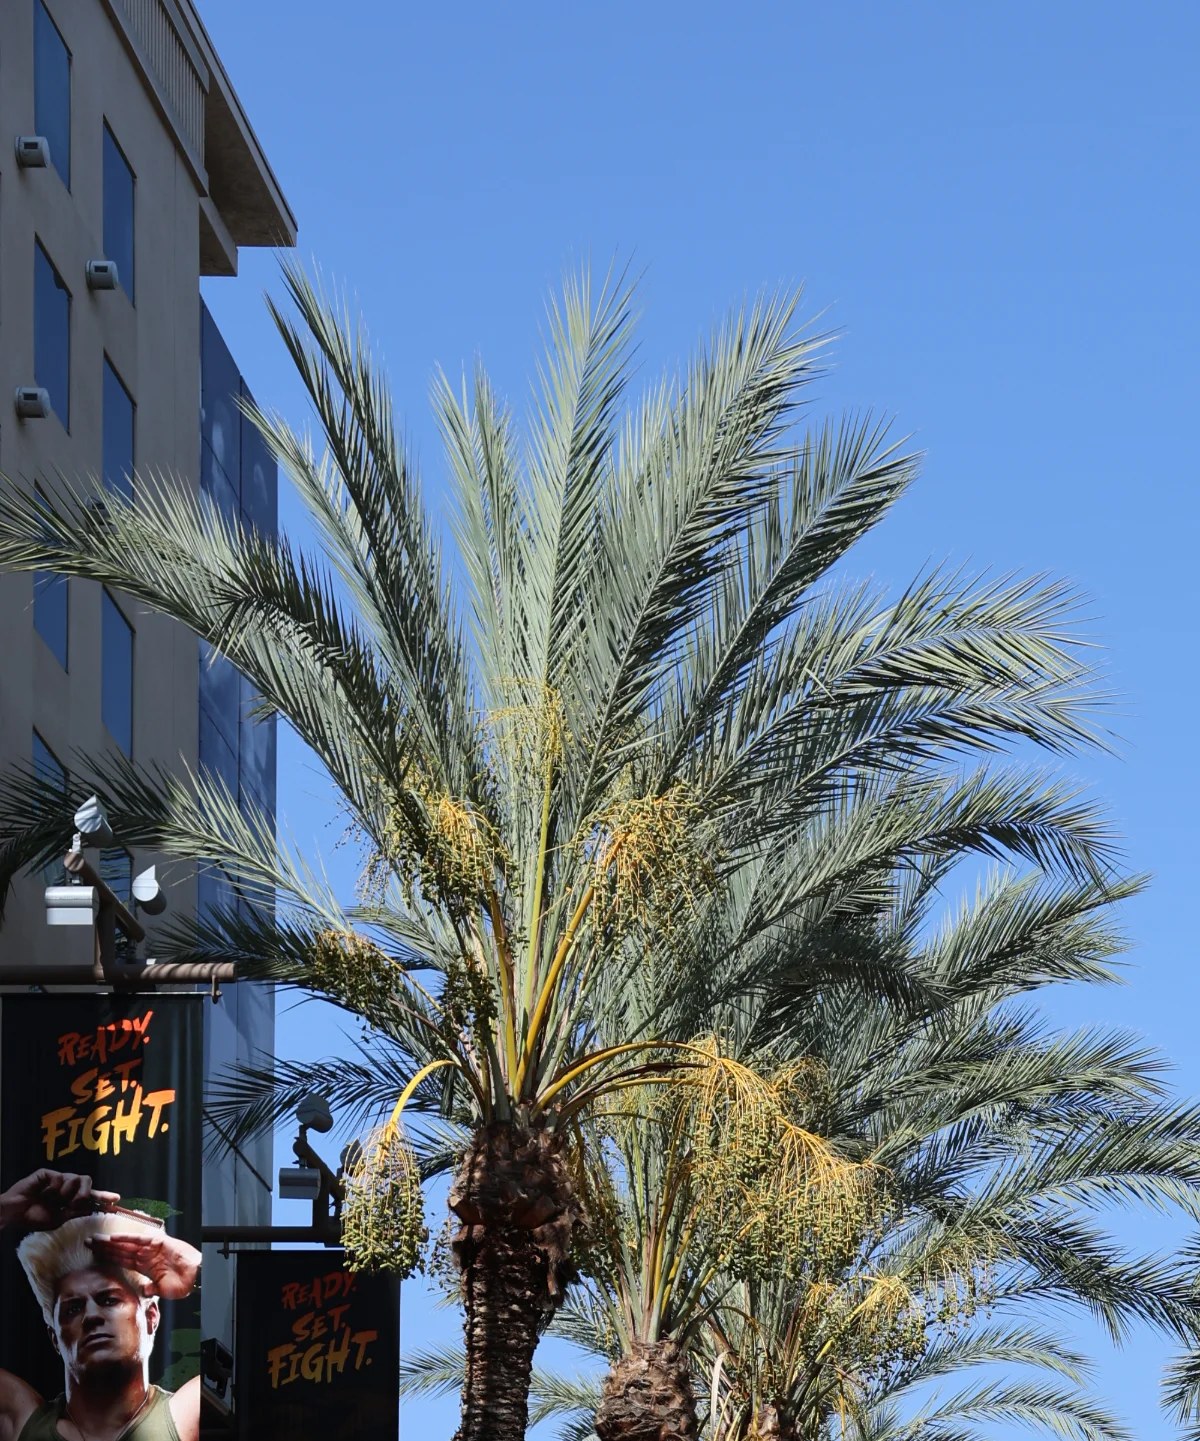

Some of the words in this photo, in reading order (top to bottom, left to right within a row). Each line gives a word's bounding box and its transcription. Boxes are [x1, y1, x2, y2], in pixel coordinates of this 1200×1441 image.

[57, 1009, 154, 1066] READY.
[70, 1057, 144, 1105] SET.
[40, 1083, 176, 1162] FIGHT.
[281, 1271, 357, 1311] READY.
[291, 1303, 351, 1342] SET.
[267, 1326, 378, 1390] FIGHT.
